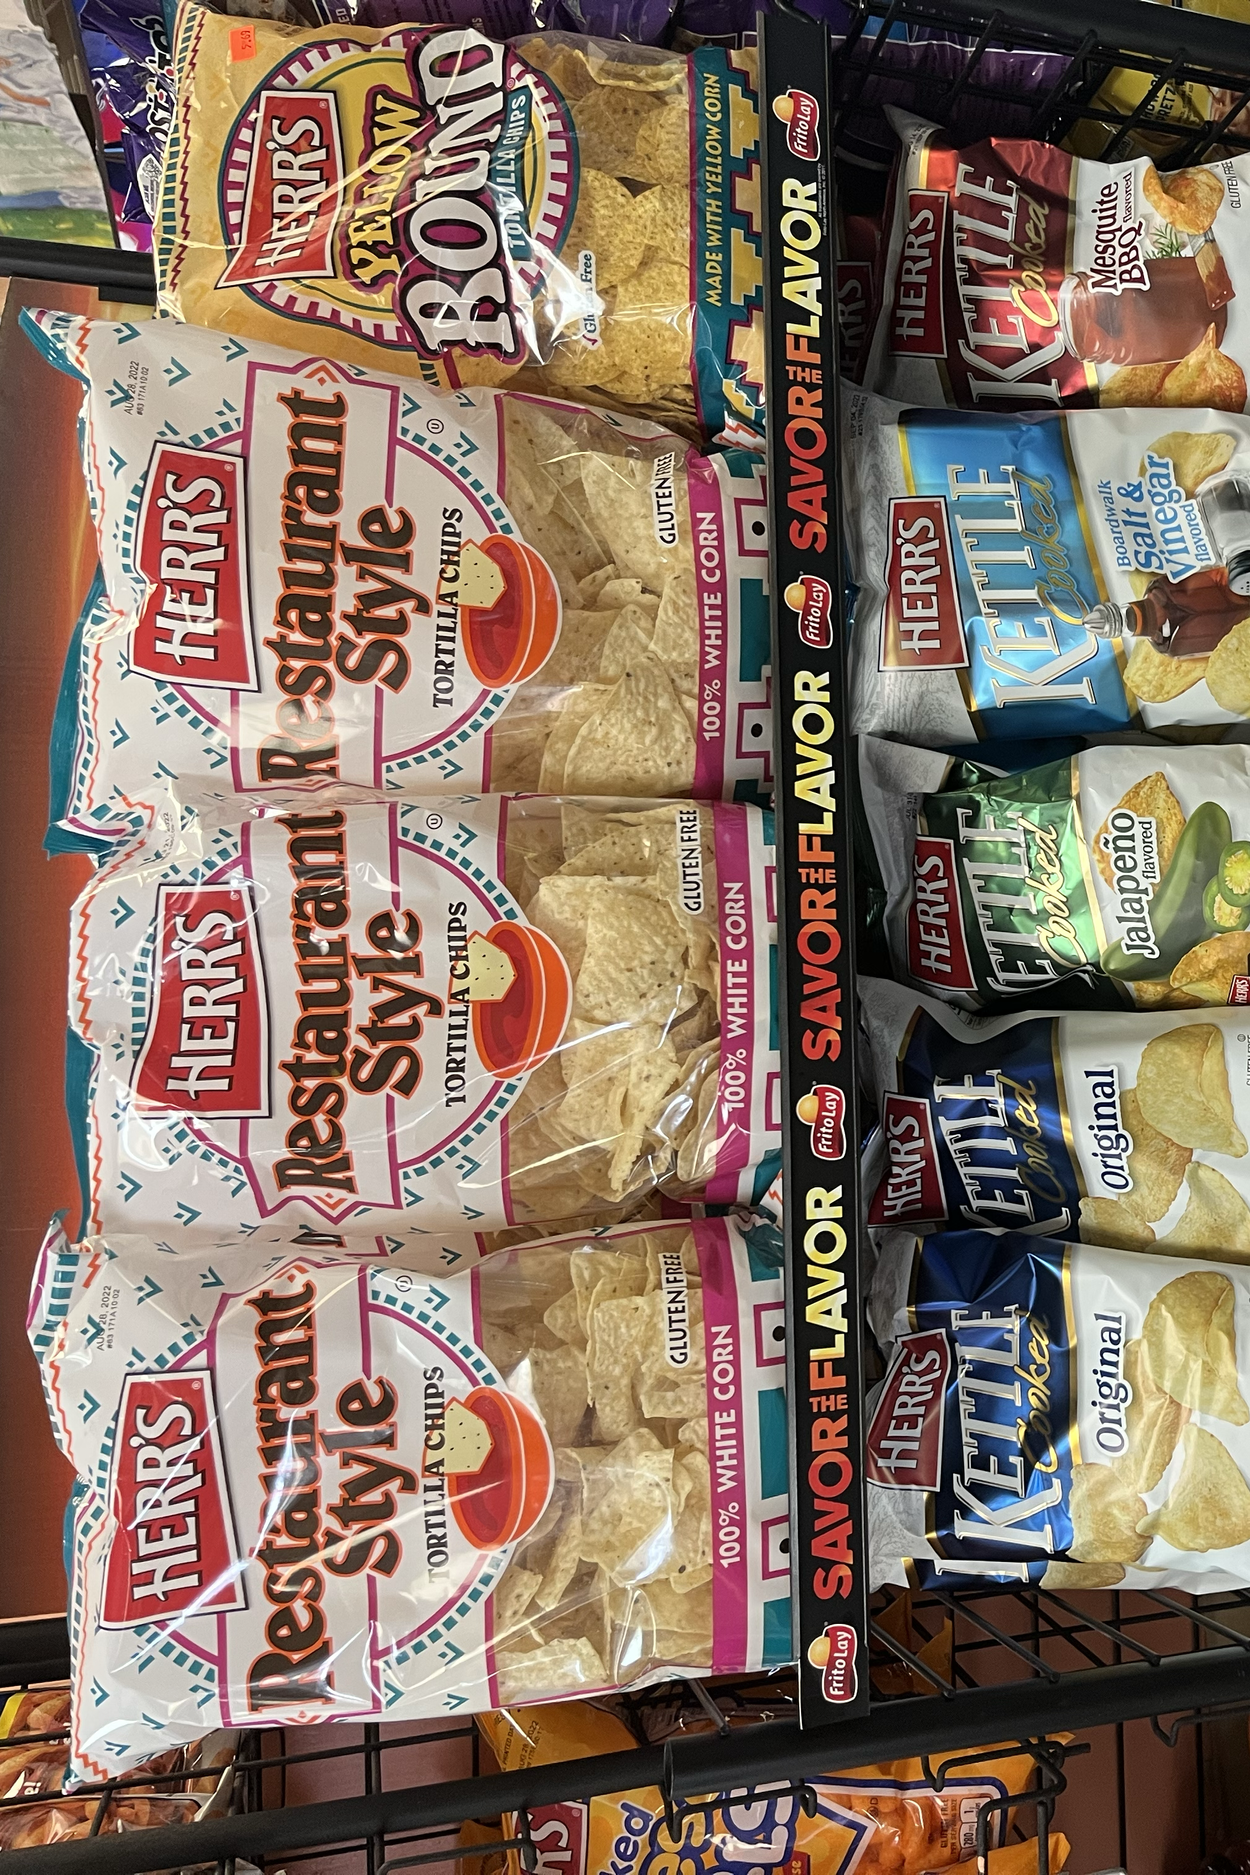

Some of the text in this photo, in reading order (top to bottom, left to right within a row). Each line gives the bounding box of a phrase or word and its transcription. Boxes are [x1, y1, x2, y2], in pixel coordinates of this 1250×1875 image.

[257, 118, 325, 267] HERR'S
[346, 93, 418, 283] YELLOW
[404, 29, 514, 351] BOUND
[498, 95, 527, 248] TORTILLA CHIPS
[704, 73, 722, 306] MADE WITH YELLOW CORN
[1010, 189, 1061, 328] Cooked
[1091, 182, 1122, 290] Mesquite
[1118, 173, 1147, 286] BBQ flavored
[128, 360, 139, 380] 2022
[781, 179, 828, 552] SAVOR FLAVOR
[954, 164, 1065, 406] KETTLE
[154, 473, 229, 665] HERR'S
[257, 387, 347, 782] Restaurant
[652, 453, 676, 544] GLUTEN FREE
[898, 516, 942, 655] HERR'S
[946, 464, 1099, 706] KETTLE
[1097, 479, 1131, 567] Boardwalk
[1117, 481, 1163, 570] Salt &
[1145, 454, 1197, 581] Vinegar
[1179, 503, 1211, 562] flavored
[333, 506, 432, 692] Style
[432, 508, 462, 708] TORTILLA CHIPS
[696, 512, 722, 741] 100% WHITE CORN
[678, 810, 702, 912] GLUTEN FREE
[793, 672, 842, 1062] SAVOR FLAVOR
[1019, 816, 1083, 968] Cooked
[1103, 812, 1156, 956] Jalapeño
[1138, 820, 1156, 880] flavored
[164, 913, 246, 1099] HERR'S
[274, 810, 358, 1194] Restaurant
[351, 910, 442, 1097] Style
[444, 901, 470, 1107] TORTILLA CHIPS
[723, 881, 747, 1112] 100% WHITE CORN
[884, 1112, 926, 1216] HERR'S
[1085, 1068, 1129, 1189] Original
[101, 1285, 112, 1308] 2022
[661, 1253, 690, 1366] GLUTEN FREE
[1092, 1313, 1129, 1453] Original
[316, 1377, 417, 1577] Style
[422, 1366, 449, 1583] TORTILLA CHIPS
[711, 1325, 741, 1569] 100% WHITE CORN
[805, 1187, 854, 1600] SAVOR THE FLAVOR
[877, 1349, 944, 1473] HERR'S
[950, 1304, 1062, 1554] KETTLE
[1016, 1313, 1059, 1472] Cooked
[129, 1401, 206, 1602] HERR'S
[245, 1279, 333, 1712] Restaurant
